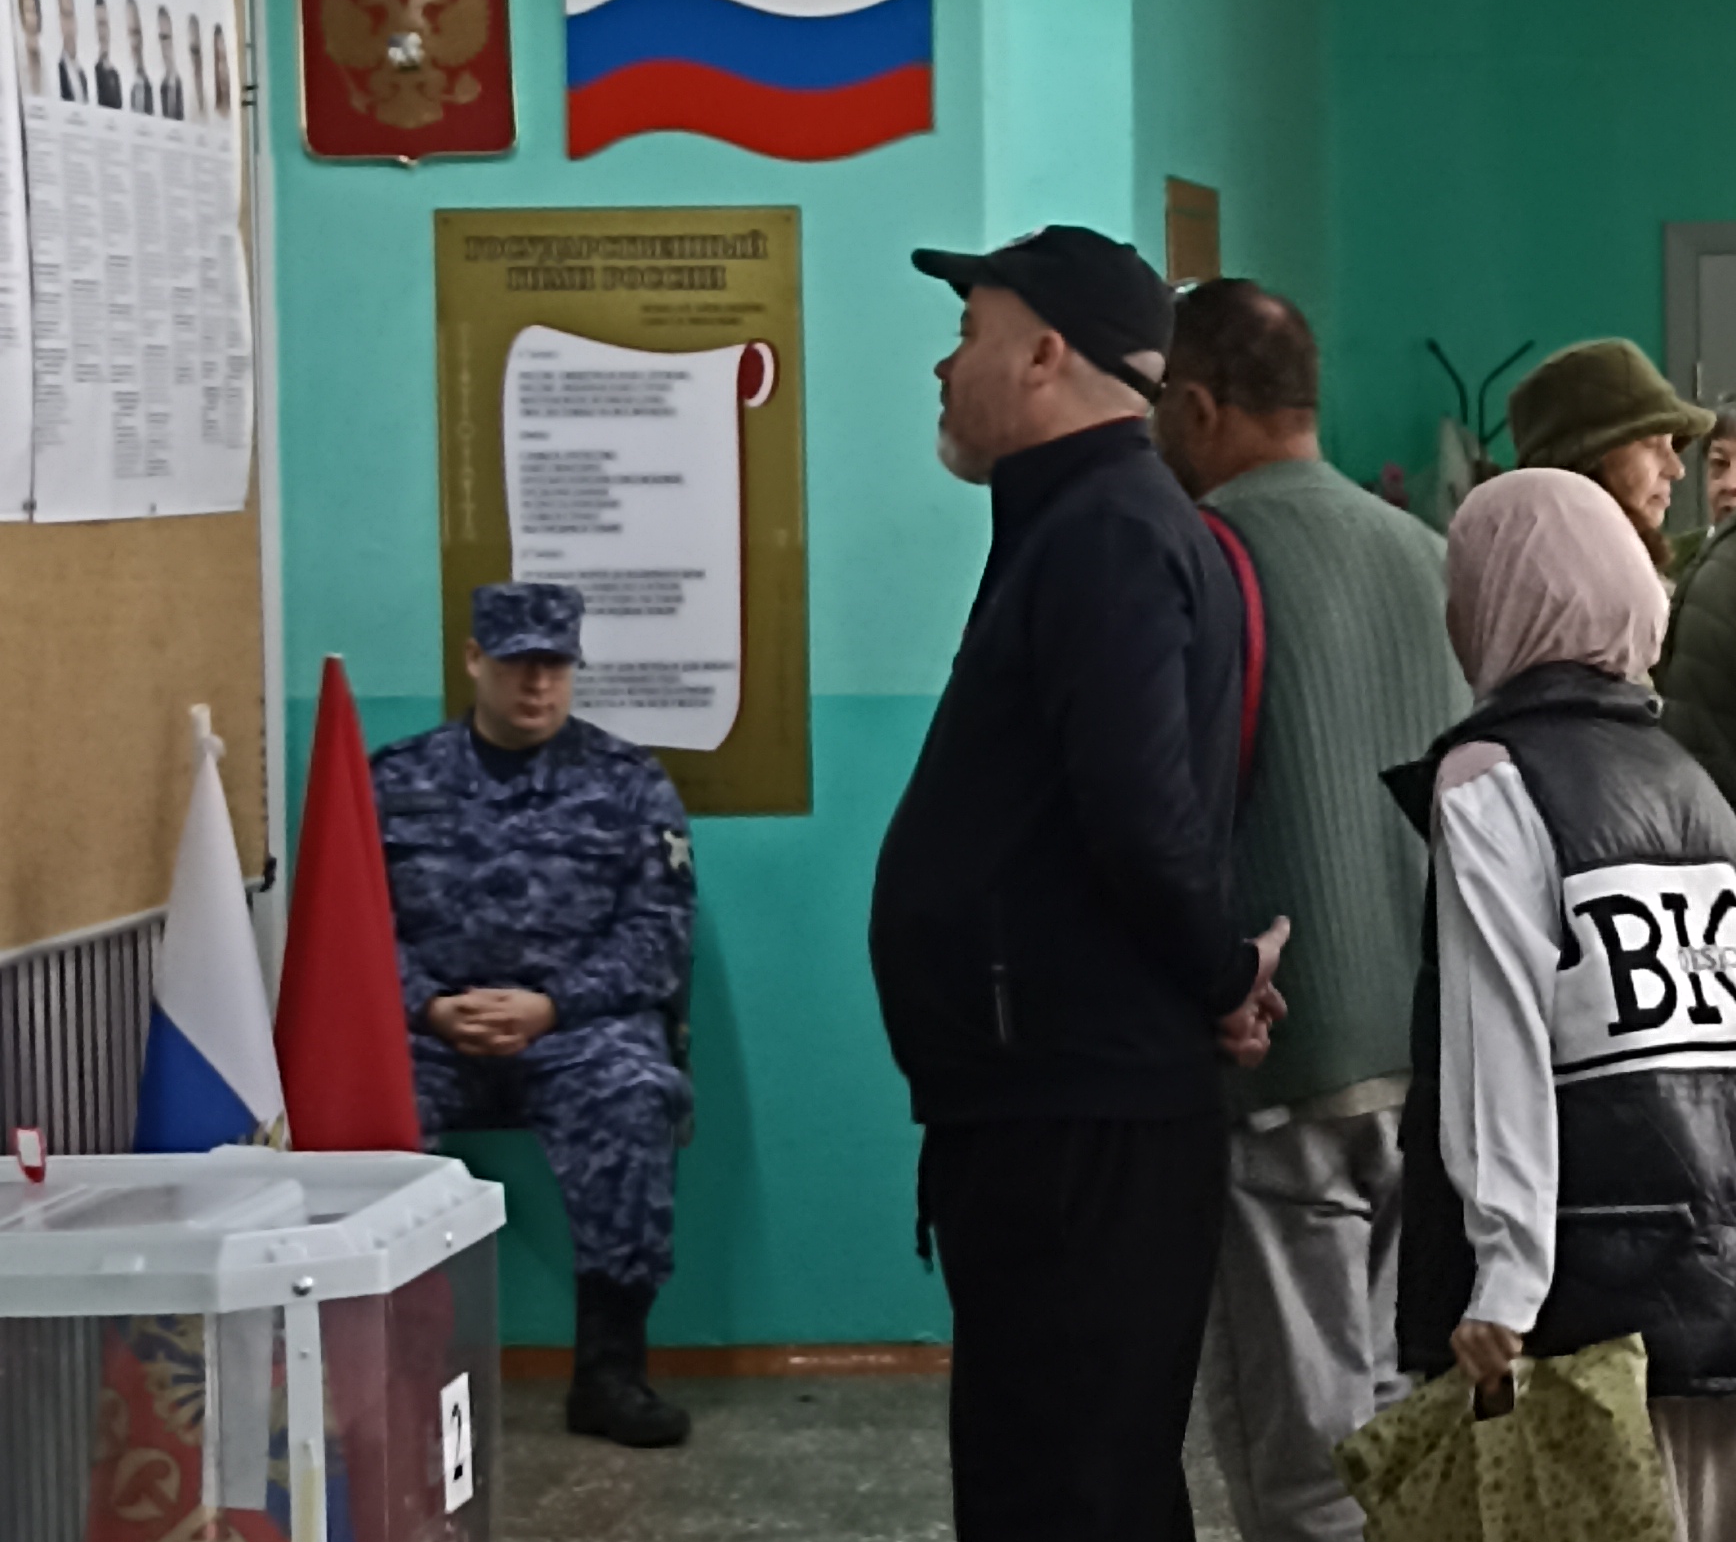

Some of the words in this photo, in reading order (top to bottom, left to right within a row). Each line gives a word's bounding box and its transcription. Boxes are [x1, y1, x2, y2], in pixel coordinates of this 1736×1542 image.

[465, 230, 768, 263] ГОСУДАРСТВЕННЫЙ
[507, 265, 595, 291] ГИМН
[602, 265, 727, 291] РОССИИ
